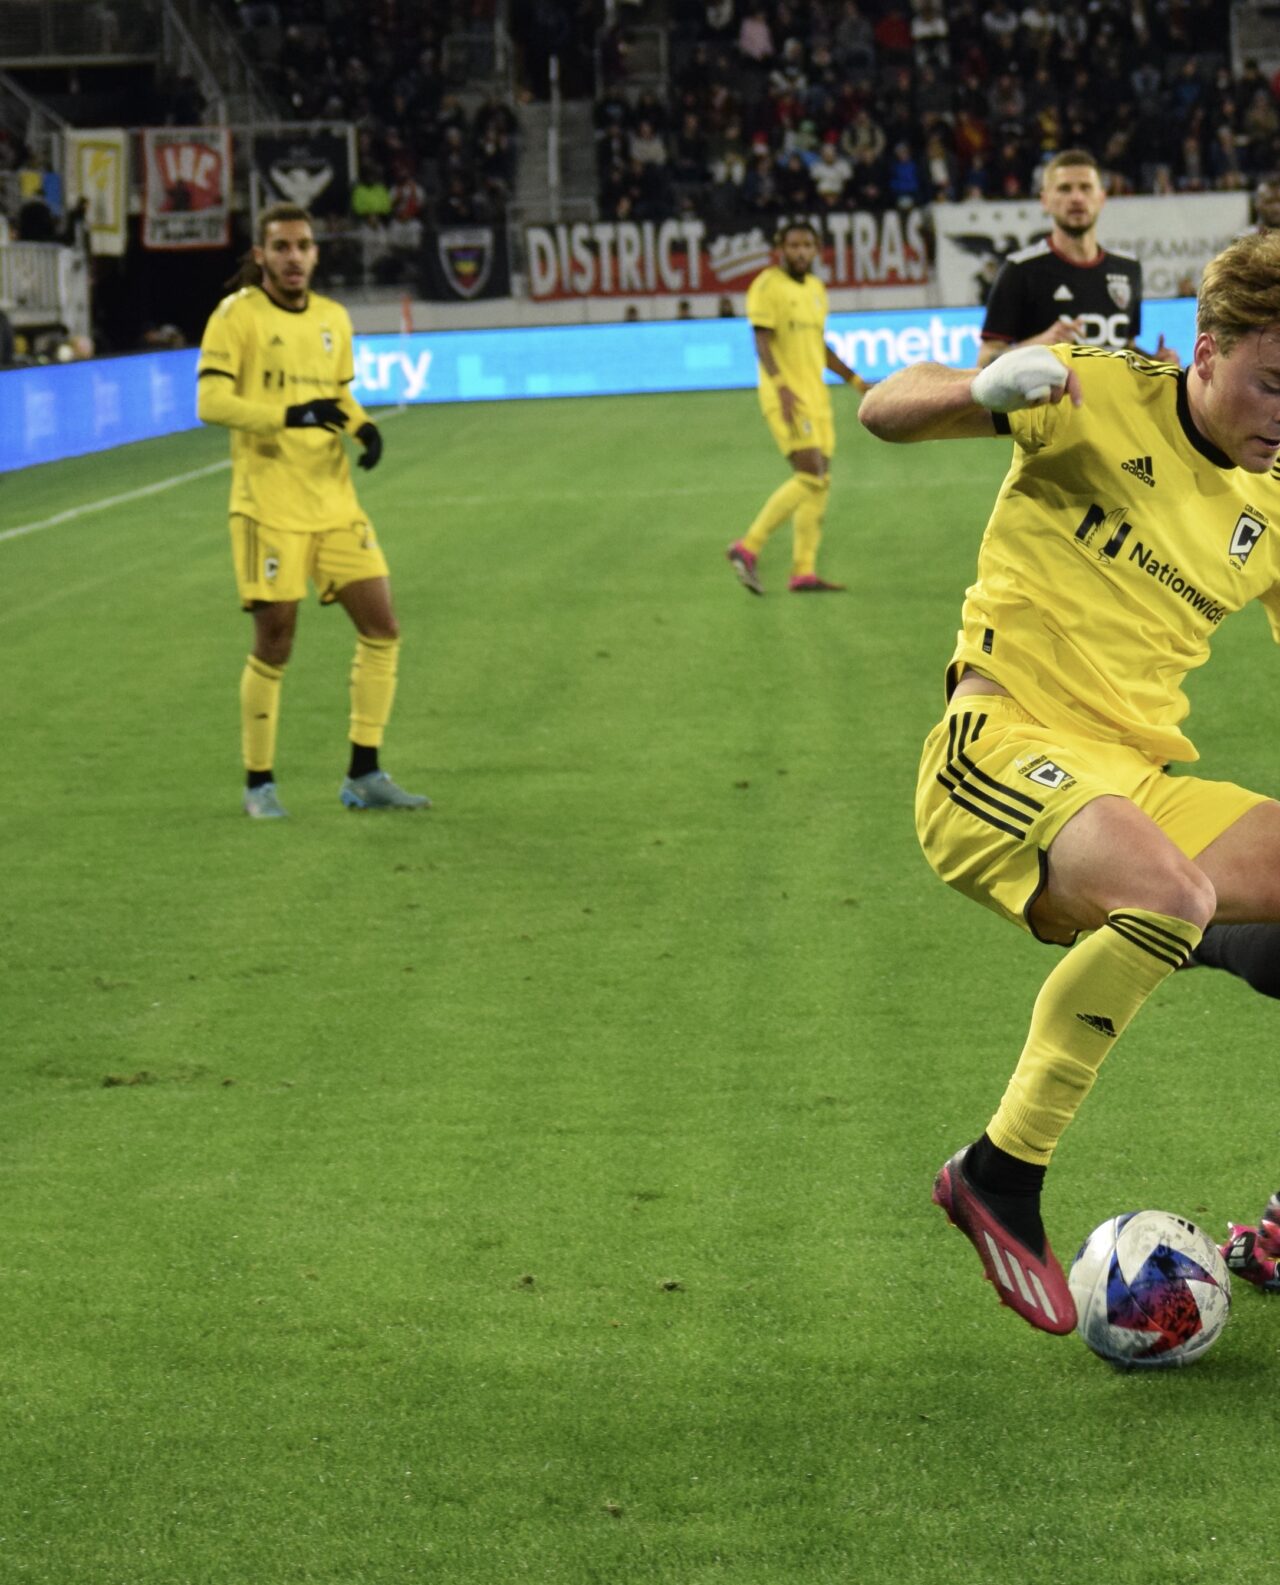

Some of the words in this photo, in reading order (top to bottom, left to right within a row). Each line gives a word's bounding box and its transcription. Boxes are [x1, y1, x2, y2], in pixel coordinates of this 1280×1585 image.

[527, 220, 705, 297] DISTRICT
[1121, 461, 1156, 488] adidas
[1128, 541, 1226, 625] Nationwide
